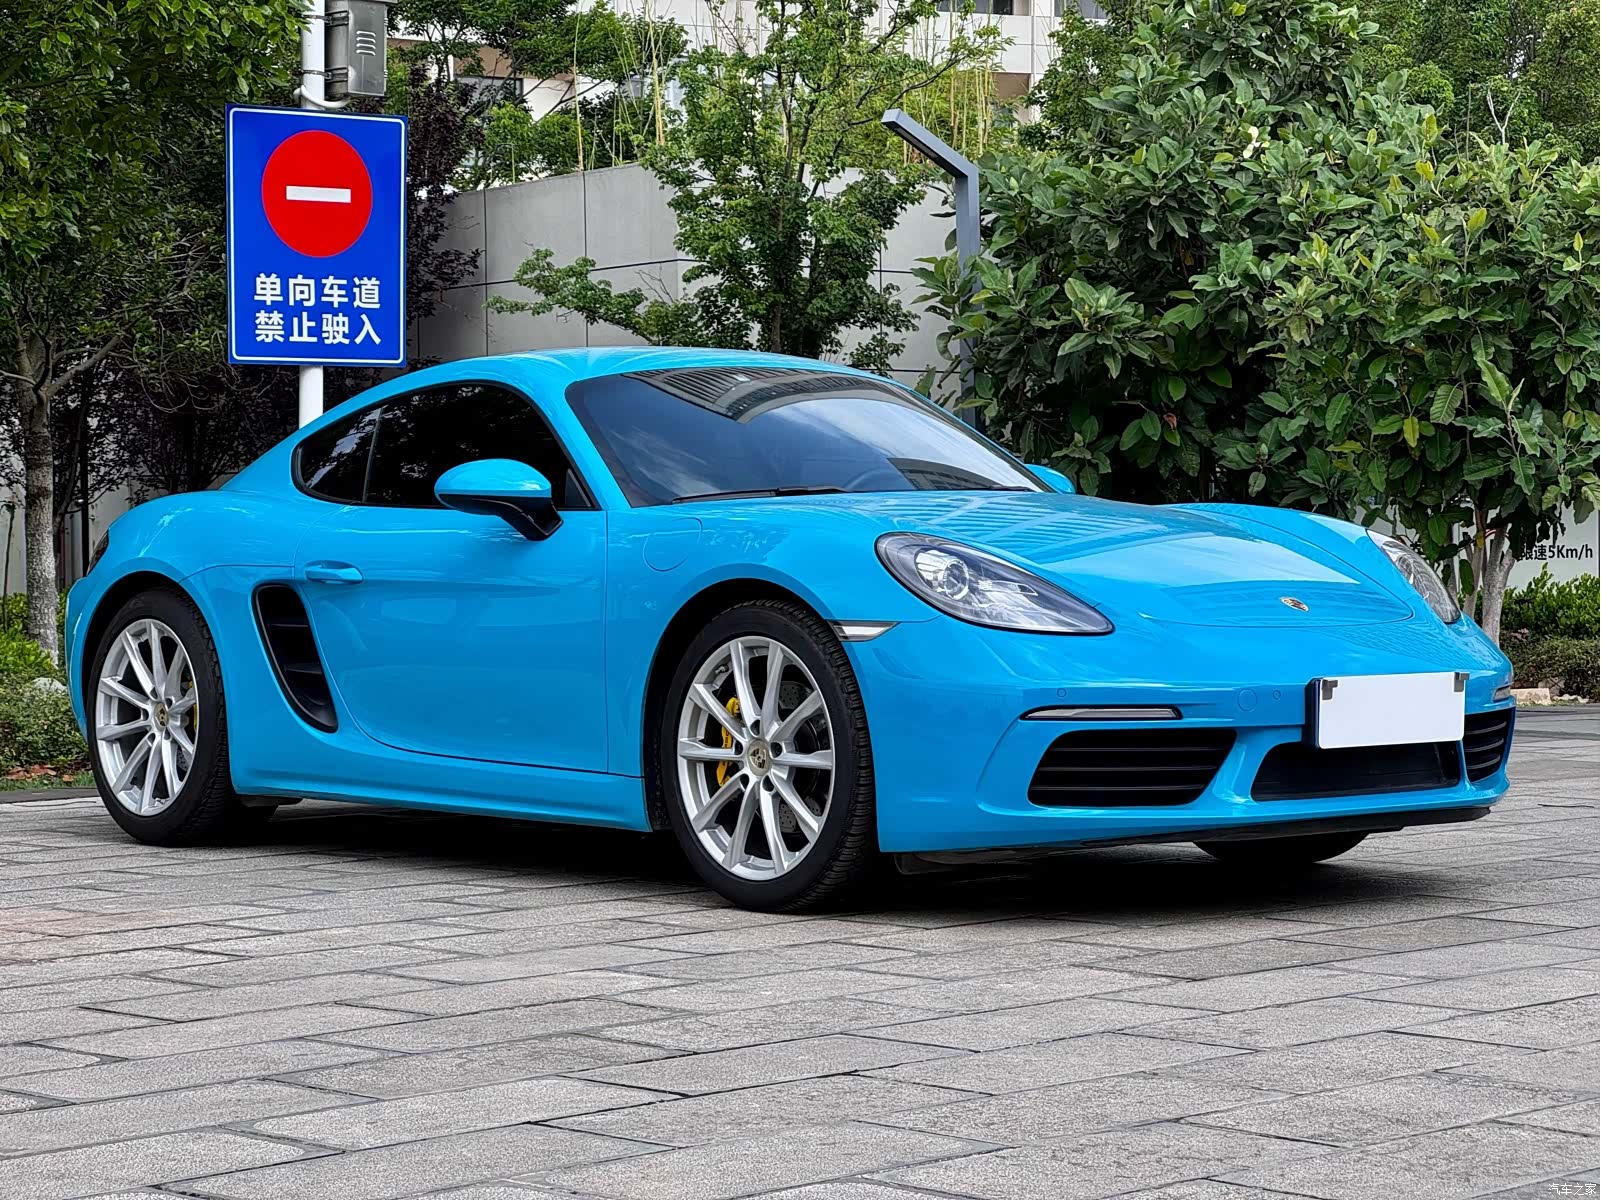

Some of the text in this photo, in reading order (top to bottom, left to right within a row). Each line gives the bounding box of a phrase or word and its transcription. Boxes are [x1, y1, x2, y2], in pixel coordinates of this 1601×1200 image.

[254, 273, 381, 308] 单向车道
[255, 310, 381, 345] 禁止驶入
